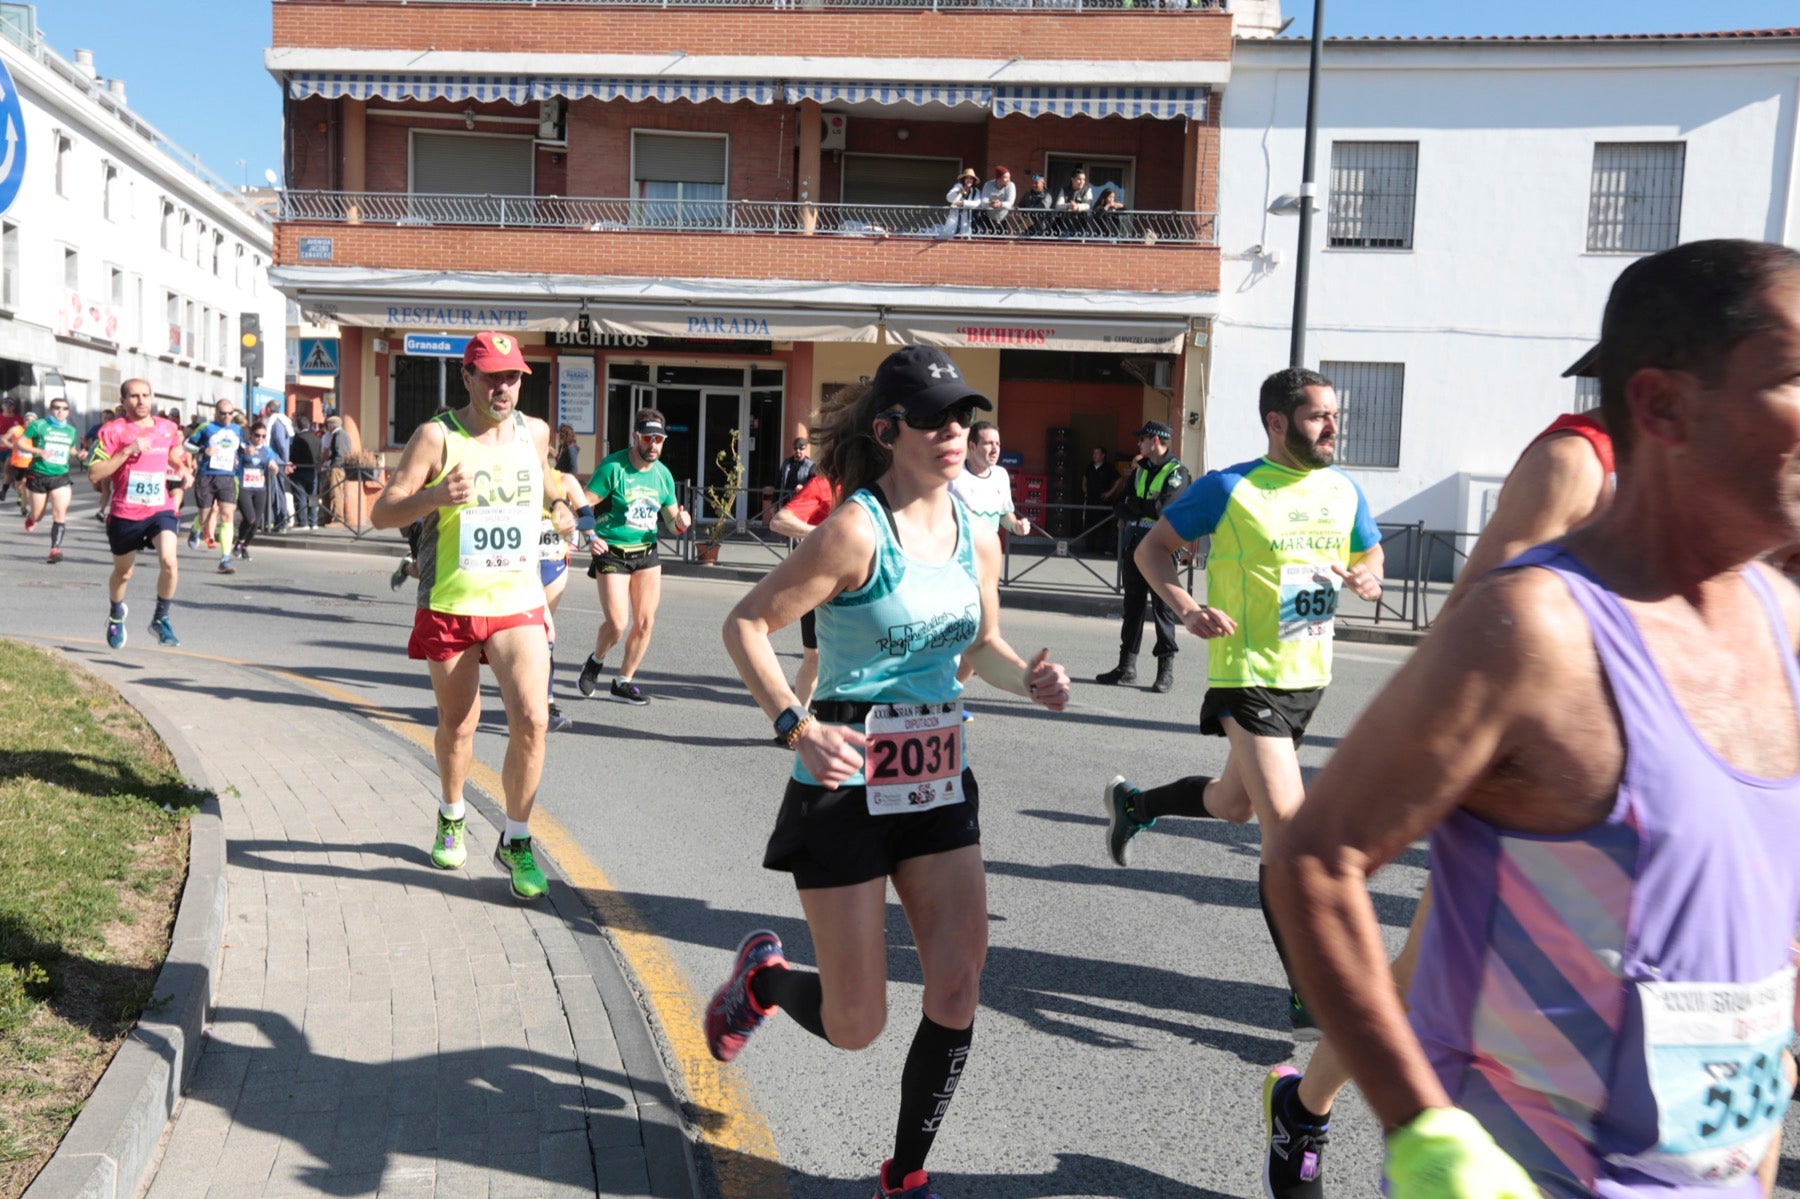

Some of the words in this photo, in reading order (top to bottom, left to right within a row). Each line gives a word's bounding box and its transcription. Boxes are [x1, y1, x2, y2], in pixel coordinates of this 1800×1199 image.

[387, 307, 528, 326] RESTAURANTE
[687, 316, 770, 335] PARADA
[407, 340, 451, 350] Granada
[555, 330, 649, 348] BICHITOS
[135, 482, 160, 496] 835
[631, 507, 654, 519] 282
[473, 527, 522, 550] 909
[1270, 536, 1345, 551] MARACEN
[1295, 588, 1336, 617] 652
[873, 732, 955, 778] 2031
